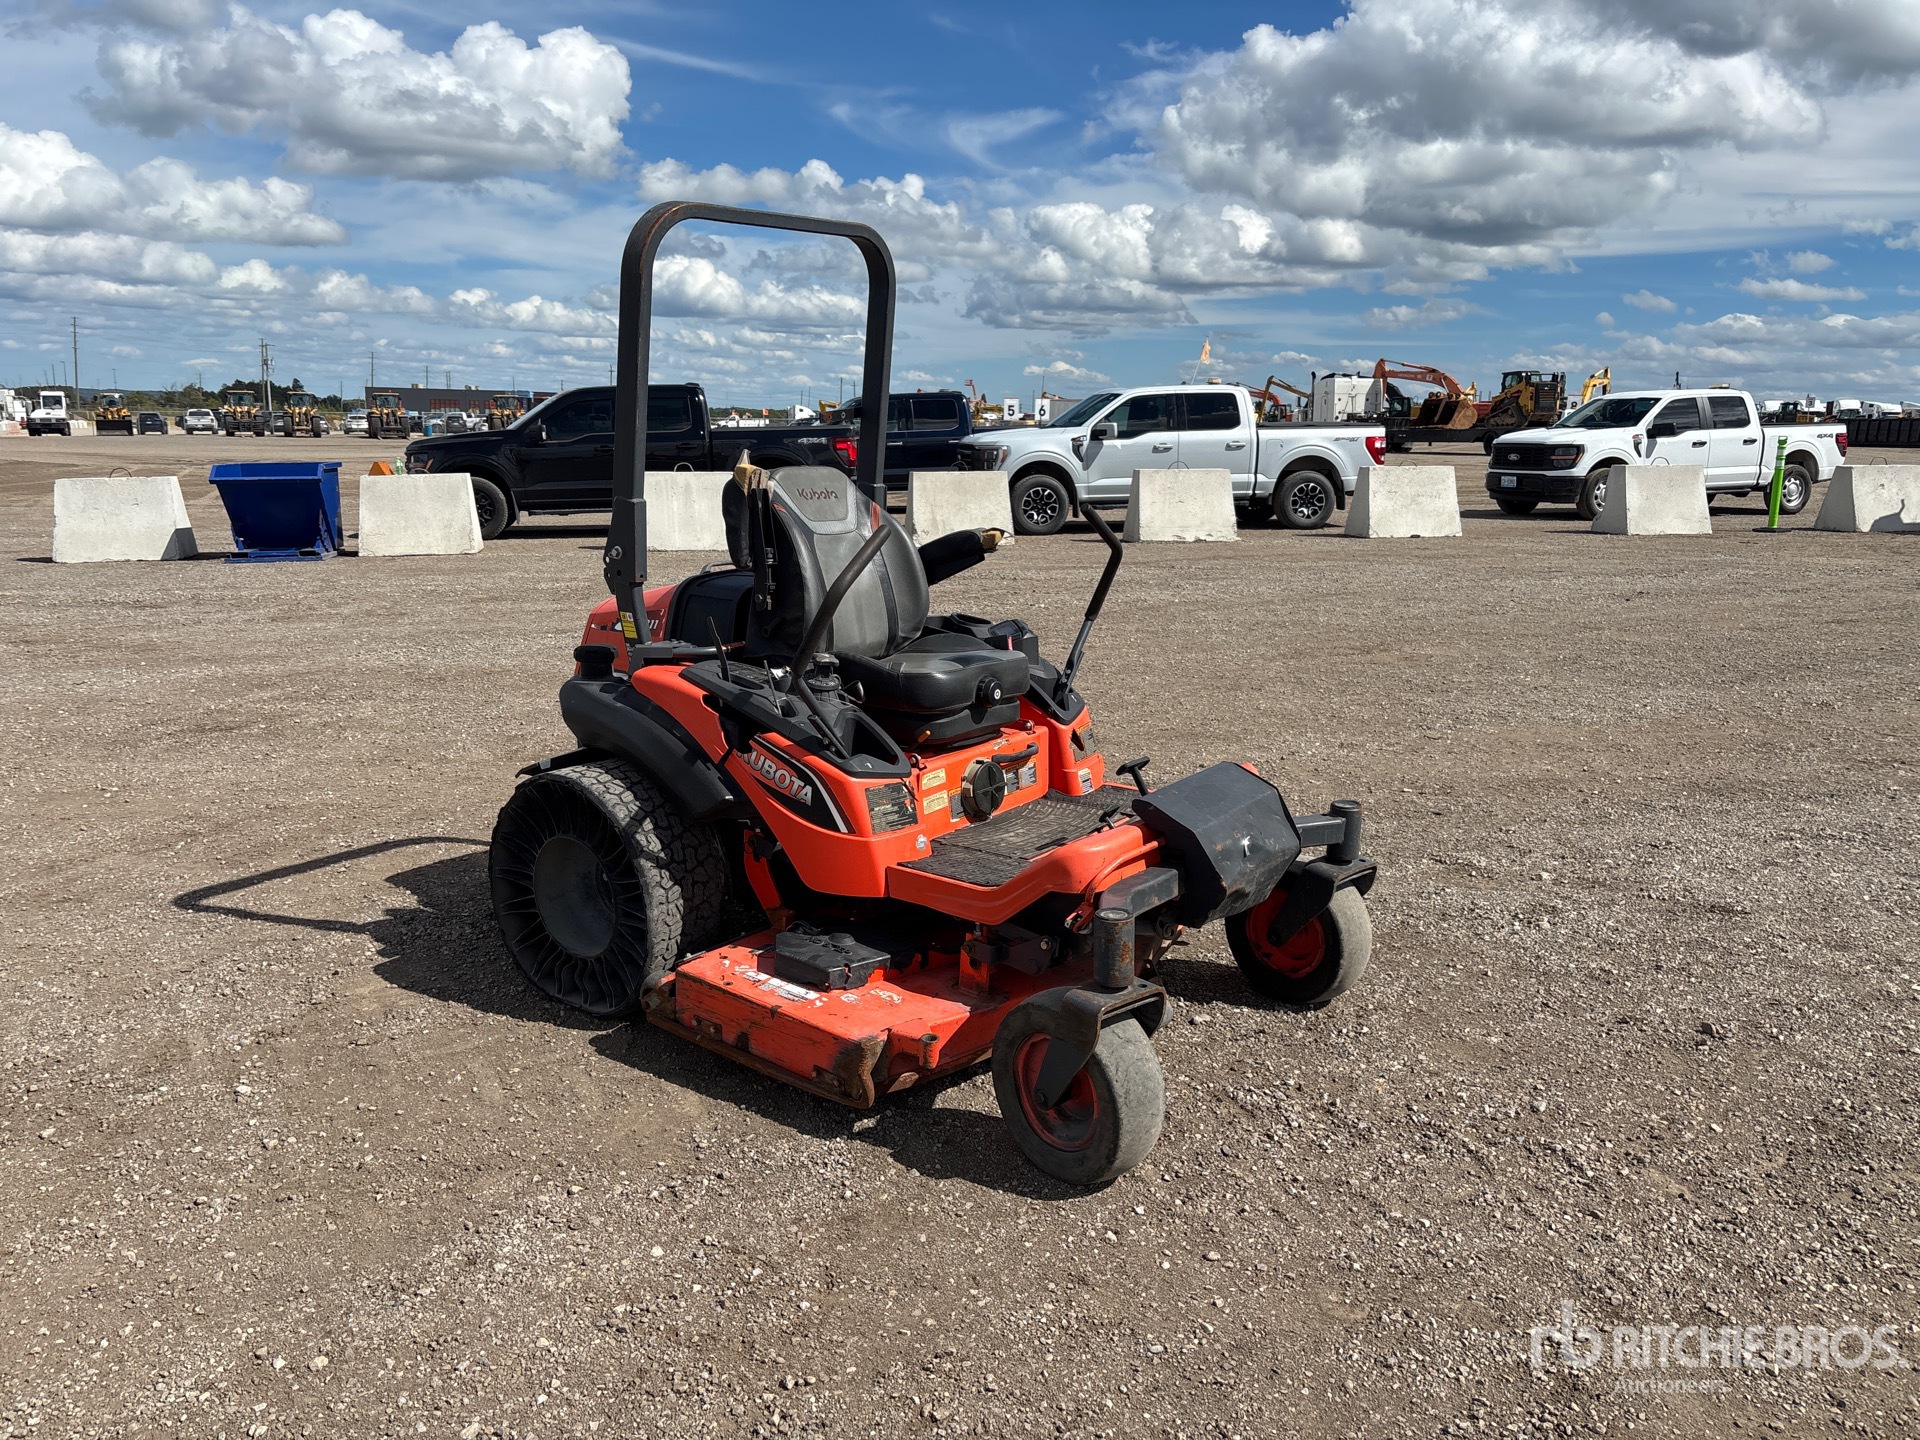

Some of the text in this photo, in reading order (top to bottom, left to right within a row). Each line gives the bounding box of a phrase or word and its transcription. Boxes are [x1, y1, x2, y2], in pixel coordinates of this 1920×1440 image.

[1007, 405, 1015, 417] 5
[1039, 405, 1046, 417] 6
[796, 487, 839, 501] Kubota
